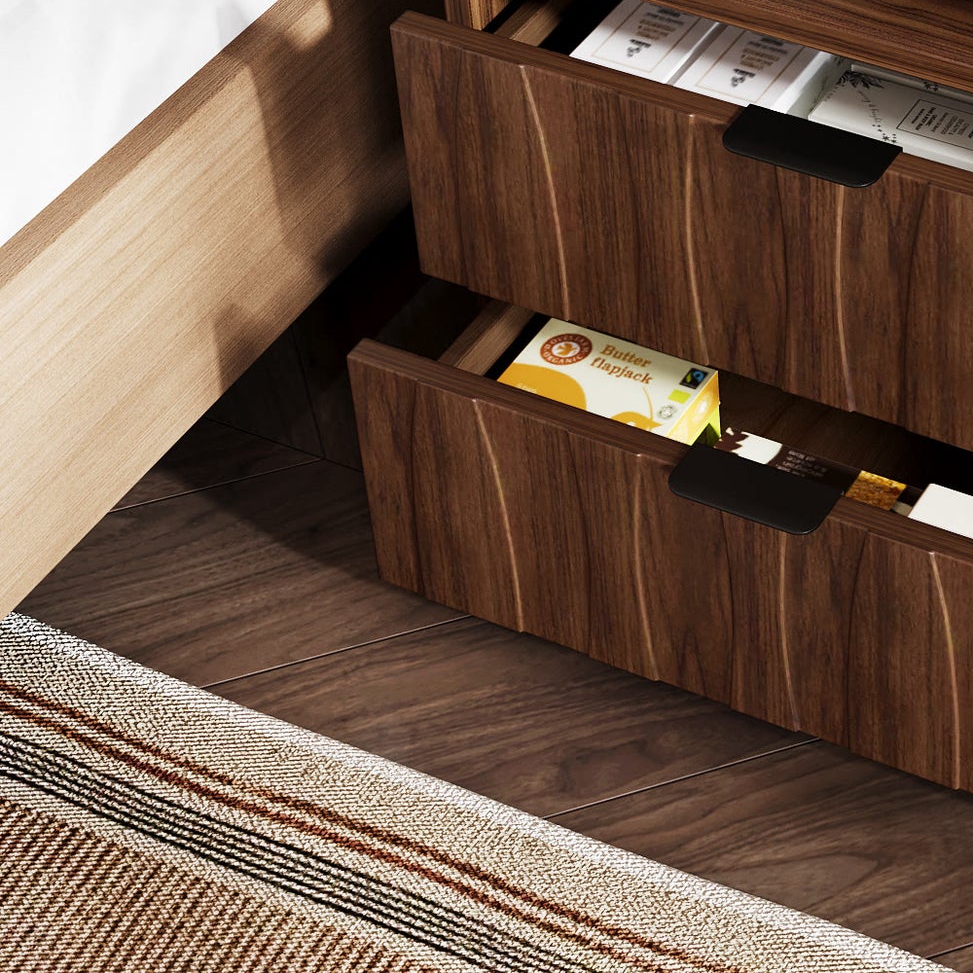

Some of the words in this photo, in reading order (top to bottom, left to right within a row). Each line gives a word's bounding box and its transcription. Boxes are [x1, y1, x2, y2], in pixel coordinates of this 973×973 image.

[543, 351, 584, 364] ORGANIC
[600, 344, 652, 368] Butter
[590, 358, 653, 385] flapjack
